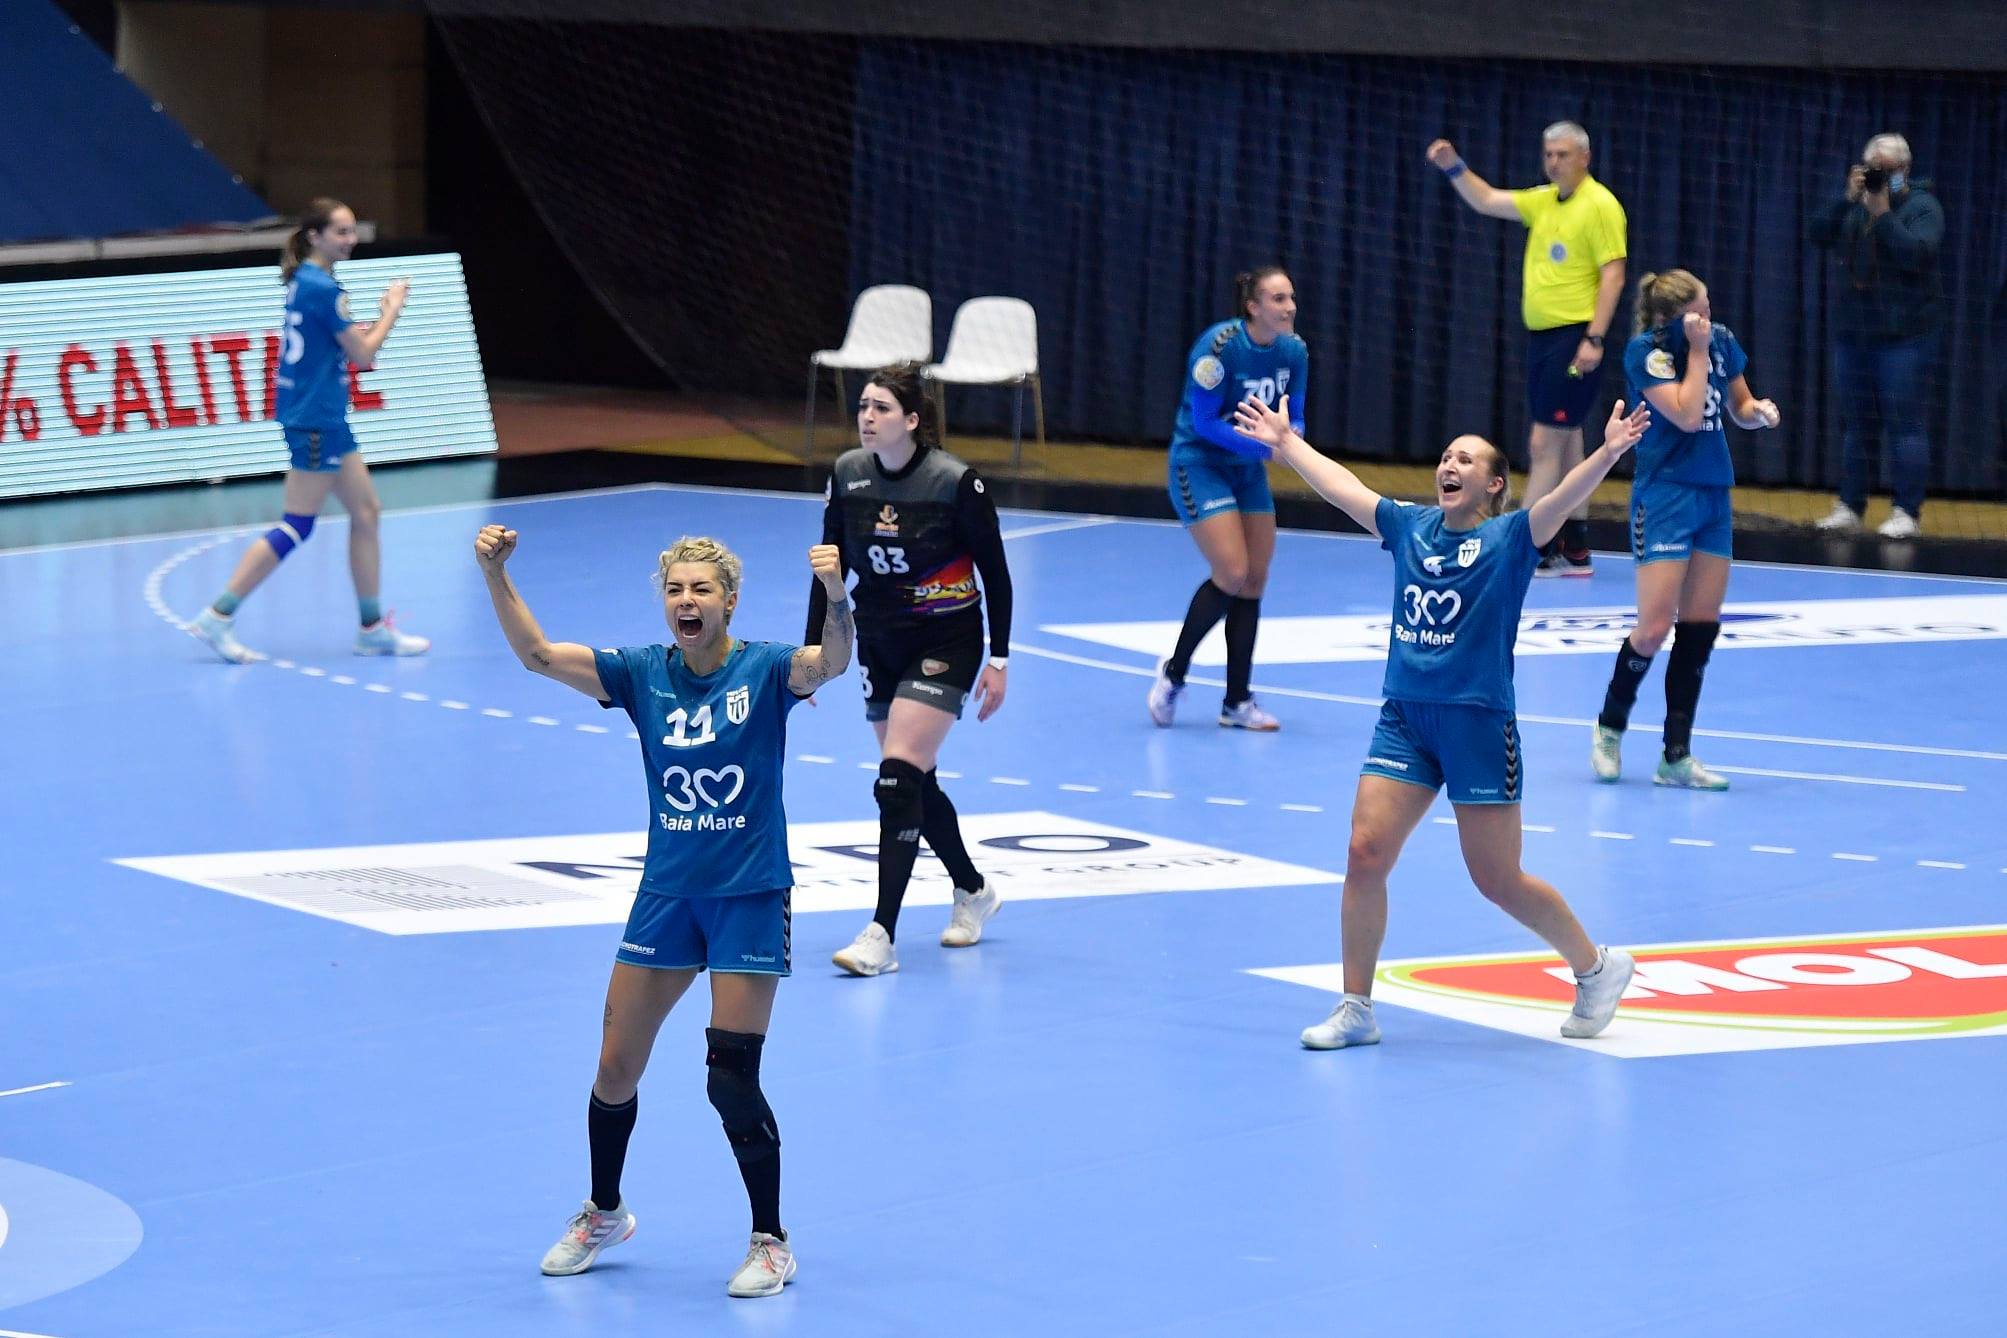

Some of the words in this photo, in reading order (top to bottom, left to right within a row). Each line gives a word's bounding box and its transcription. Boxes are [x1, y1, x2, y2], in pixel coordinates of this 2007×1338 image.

[59, 325, 384, 436] CALITE
[868, 545, 910, 575] 83
[663, 705, 716, 747] 11
[659, 813, 692, 831] Baia
[698, 814, 746, 831] Mare
